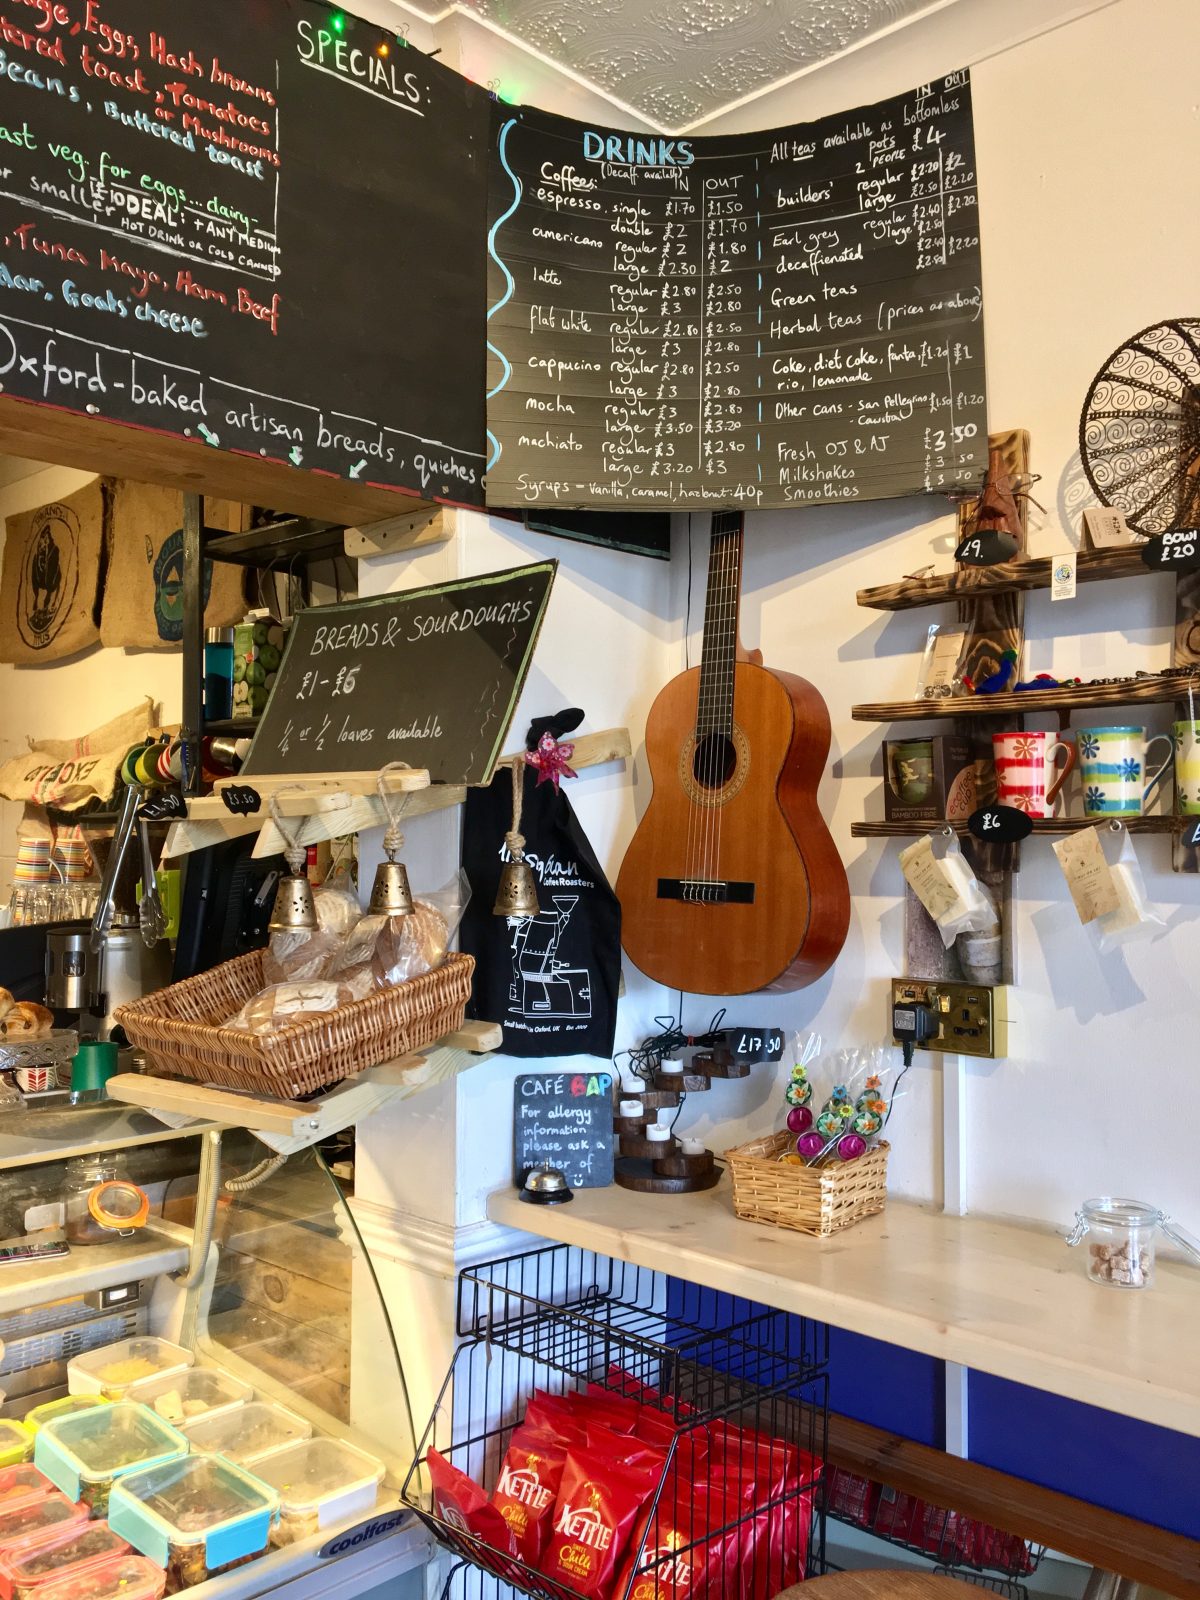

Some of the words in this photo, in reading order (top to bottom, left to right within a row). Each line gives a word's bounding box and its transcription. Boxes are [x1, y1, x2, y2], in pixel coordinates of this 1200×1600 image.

[80, 44, 149, 94] toast
[150, 31, 204, 78] Hash
[211, 57, 276, 106] browns
[297, 20, 431, 104] SPECIALS:
[104, 101, 196, 151] Buttered
[206, 144, 264, 181] toast
[155, 106, 175, 121] or
[183, 112, 281, 167] Mushrooms
[770, 141, 789, 163] All
[792, 140, 817, 156] teas
[823, 123, 873, 149] available
[881, 121, 893, 132] as
[903, 95, 960, 126] bottomless
[583, 131, 695, 166] DRINKS
[869, 134, 896, 162] pots
[912, 125, 948, 152] £4
[99, 151, 132, 186] for
[872, 148, 907, 168] PEOPLE
[706, 175, 744, 189] OUT
[857, 168, 904, 197] regular
[911, 161, 939, 182] £2.20
[859, 193, 896, 212] large
[910, 181, 938, 198] £2.50
[945, 172, 974, 190] £2.20
[612, 199, 651, 225] single
[665, 202, 696, 216] £1.70
[708, 202, 743, 216] £1.50
[206, 221, 236, 242] ANY
[611, 217, 653, 236] double
[663, 222, 688, 241] £2
[708, 220, 747, 239] £1.70
[773, 232, 801, 248] Earl
[803, 230, 839, 252] grey
[863, 210, 907, 239] regular
[887, 225, 913, 245] large
[121, 217, 145, 233] HOT
[149, 225, 185, 248] DRINK
[189, 240, 204, 251] OR
[208, 246, 235, 262] COLD
[238, 255, 282, 276] CANNED
[532, 227, 603, 248] americano
[615, 241, 658, 262] regular
[661, 241, 687, 259] £2
[708, 241, 747, 258] £1.80
[533, 267, 562, 285] latte
[613, 256, 649, 281] large
[658, 259, 697, 277] £2.30
[709, 259, 732, 276] £2
[609, 282, 658, 303] regular
[661, 282, 697, 299] £2.80
[708, 283, 742, 299] £2.50
[771, 288, 816, 308] Green
[822, 282, 858, 301] teas
[135, 301, 208, 338] cheese
[238, 287, 281, 336] Beef
[530, 304, 555, 334] flat
[562, 310, 592, 332] white
[609, 324, 660, 344] regular
[663, 320, 698, 338] £2.80
[706, 322, 742, 338] £2.50
[611, 298, 648, 326] large
[661, 300, 682, 315] £3
[706, 301, 742, 316] £2.80
[770, 314, 822, 340] Herbal
[827, 312, 862, 328] teas
[611, 337, 647, 364] large
[662, 341, 681, 357] £3
[705, 340, 740, 356] £2.80
[814, 349, 842, 371] diet
[954, 343, 973, 365] £1
[528, 356, 601, 381] cappucino
[610, 358, 659, 384] regular
[705, 361, 740, 376] £2.50
[812, 368, 873, 387] lemonade
[609, 381, 648, 405] large
[656, 385, 678, 400] £3
[704, 386, 741, 401] £2.80
[526, 395, 575, 414] mocha
[604, 404, 655, 425] regular
[657, 405, 677, 420] £3
[703, 401, 743, 418] £2.80
[775, 401, 806, 420] Other
[813, 404, 843, 416] cans
[857, 400, 880, 411] San
[225, 403, 304, 441] artisan
[413, 454, 477, 489] quiches
[518, 432, 583, 450] machiato
[602, 439, 652, 461] regular
[655, 442, 675, 457] £3
[703, 442, 745, 456] £2.80
[605, 420, 646, 446] large
[655, 422, 693, 437] £3.50
[704, 421, 742, 434] £3.20
[777, 441, 816, 462] Fresh
[826, 440, 848, 457] OJ
[854, 438, 867, 454] &
[870, 435, 890, 451] AJ
[603, 457, 644, 486] large
[651, 460, 693, 476] £3.20
[706, 459, 727, 475] £3
[779, 465, 855, 485] Milkshakes
[516, 473, 570, 501] Syrups
[733, 483, 763, 506] 40p
[784, 484, 859, 501] Smoothies
[1161, 543, 1195, 562] £20
[310, 622, 379, 656] BREADS
[382, 616, 402, 647] &
[407, 600, 533, 642] SOURDOUGHS
[300, 726, 311, 741] or
[337, 715, 374, 743] loaves
[387, 714, 443, 740] available
[227, 791, 254, 805] £5.50
[982, 812, 1001, 831] £6
[559, 878, 595, 888] Roasters
[737, 1034, 781, 1053] £17.50
[521, 1104, 541, 1118] For
[548, 1105, 591, 1124] allergy
[523, 1122, 587, 1140] information
[523, 1138, 562, 1157] please
[568, 1140, 589, 1151] ask
[596, 1141, 606, 1149] a
[580, 1153, 594, 1173] of
[496, 1465, 553, 1509] KETTLE
[329, 1513, 405, 1556] coolfast
[554, 1503, 613, 1551] KETTLE
[560, 1545, 591, 1570] Chilli
